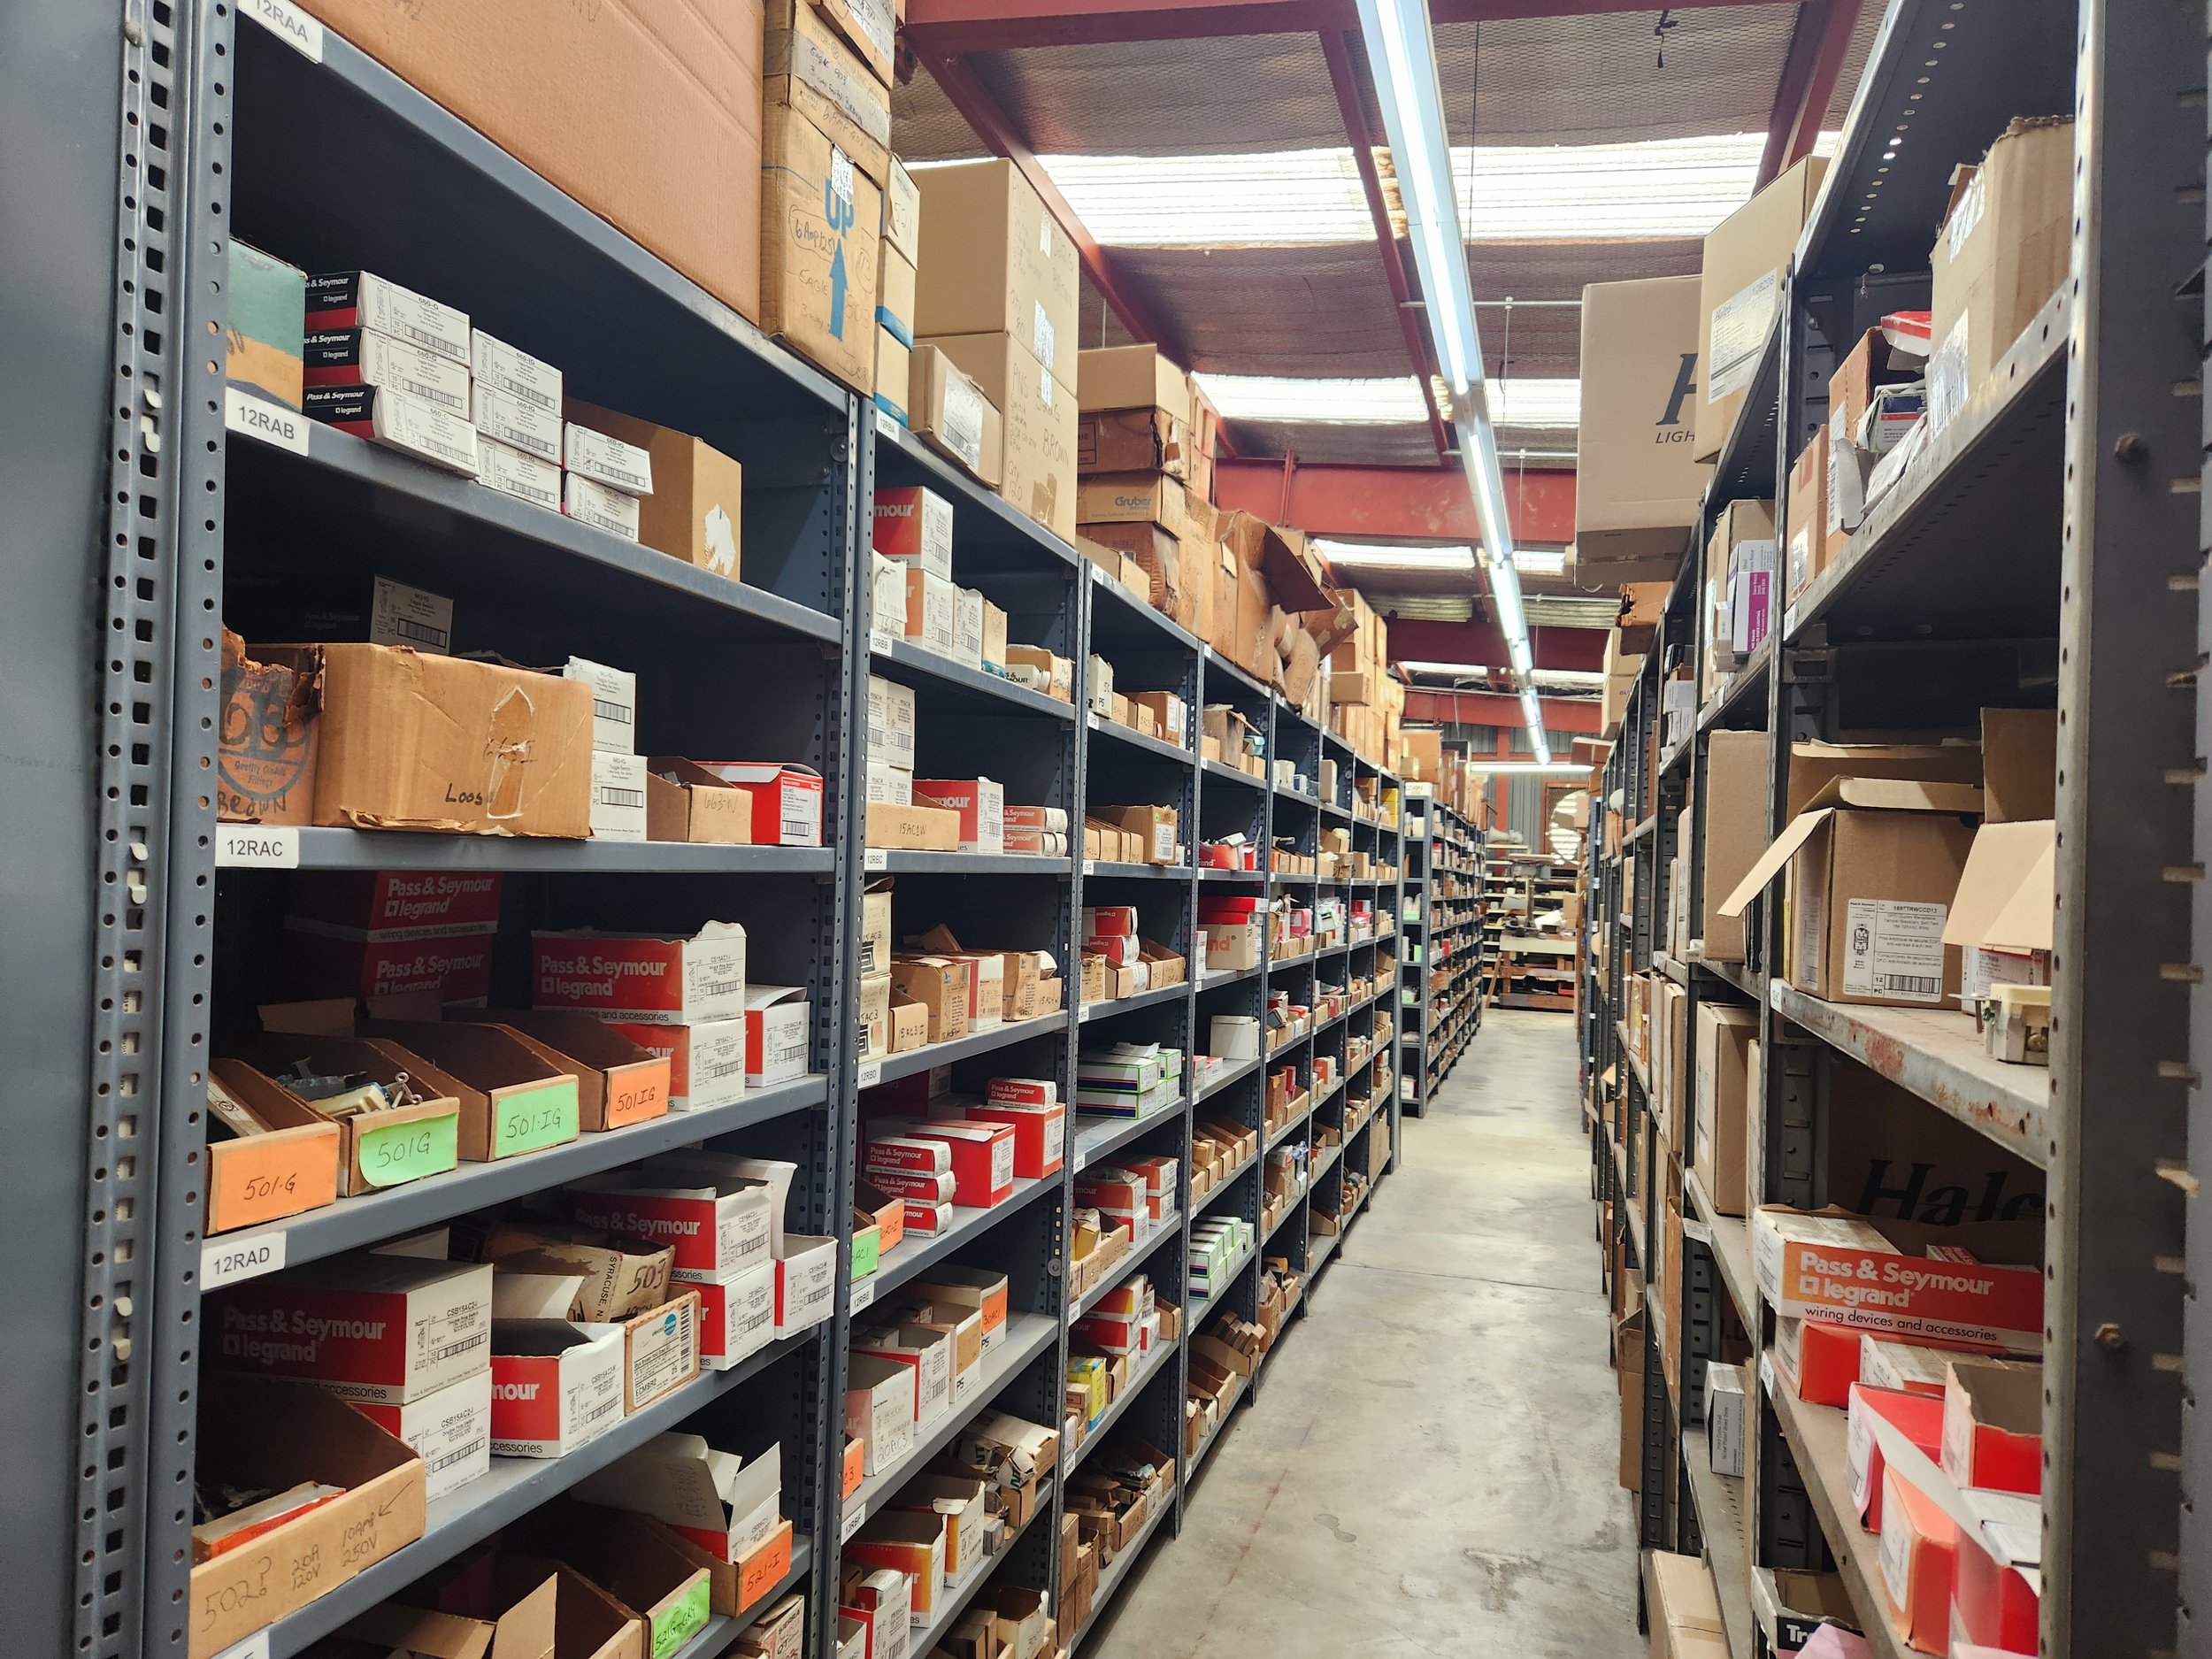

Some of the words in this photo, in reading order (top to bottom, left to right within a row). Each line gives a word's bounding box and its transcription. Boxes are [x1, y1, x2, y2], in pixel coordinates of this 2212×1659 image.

[257, 0, 308, 42] 12RAA
[319, 276, 349, 289] Seymour
[328, 294, 348, 303] legrand
[319, 333, 350, 345] Seymour
[328, 349, 348, 359] legrand
[307, 392, 324, 401] Pass
[333, 390, 365, 402] Seymour
[342, 405, 361, 415] legrand
[239, 405, 295, 440] 12RAB
[1655, 431, 1694, 443] LIGH
[874, 503, 915, 517] mour
[1115, 496, 1151, 507] Gruber
[445, 783, 489, 804] Loos
[227, 839, 283, 856] 12RAC
[388, 878, 422, 897] Pass
[423, 876, 435, 895] &
[438, 876, 494, 896] Seymour
[399, 897, 450, 920] legrand
[377, 960, 411, 979] Pass
[412, 956, 425, 974] &
[427, 952, 484, 976] Seymour
[541, 956, 573, 974] Pass
[575, 956, 592, 975] &
[594, 956, 667, 979] Seymour
[557, 979, 613, 999] legrand
[602, 1010, 618, 1019] and
[619, 1010, 669, 1022] accessories
[861, 1009, 879, 1025] 5AC3
[877, 1156, 901, 1164] legrand
[892, 1149, 922, 1158] Seymour
[244, 1172, 297, 1201] 501-G
[896, 1178, 926, 1187] Seymour
[610, 1211, 625, 1230] &
[627, 1212, 701, 1239] Seymour
[213, 1247, 271, 1274] 12RAD
[599, 1256, 618, 1307] SYRACUSE,
[1801, 1251, 1853, 1277] Pass
[1857, 1259, 1879, 1282] &
[1883, 1263, 1994, 1295] Seymour
[1824, 1279, 1910, 1308] legrand
[223, 1306, 273, 1333] Pass
[273, 1309, 289, 1333] &
[291, 1310, 386, 1342] Seymour
[1806, 1307, 1844, 1324] wiring
[1847, 1310, 1893, 1328] devices
[1897, 1319, 1922, 1331] and
[1925, 1325, 1997, 1341] accessories
[243, 1339, 317, 1365] legrand
[492, 1383, 540, 1402] mour
[490, 1441, 543, 1454] ccessories
[342, 1532, 378, 1568] 250V
